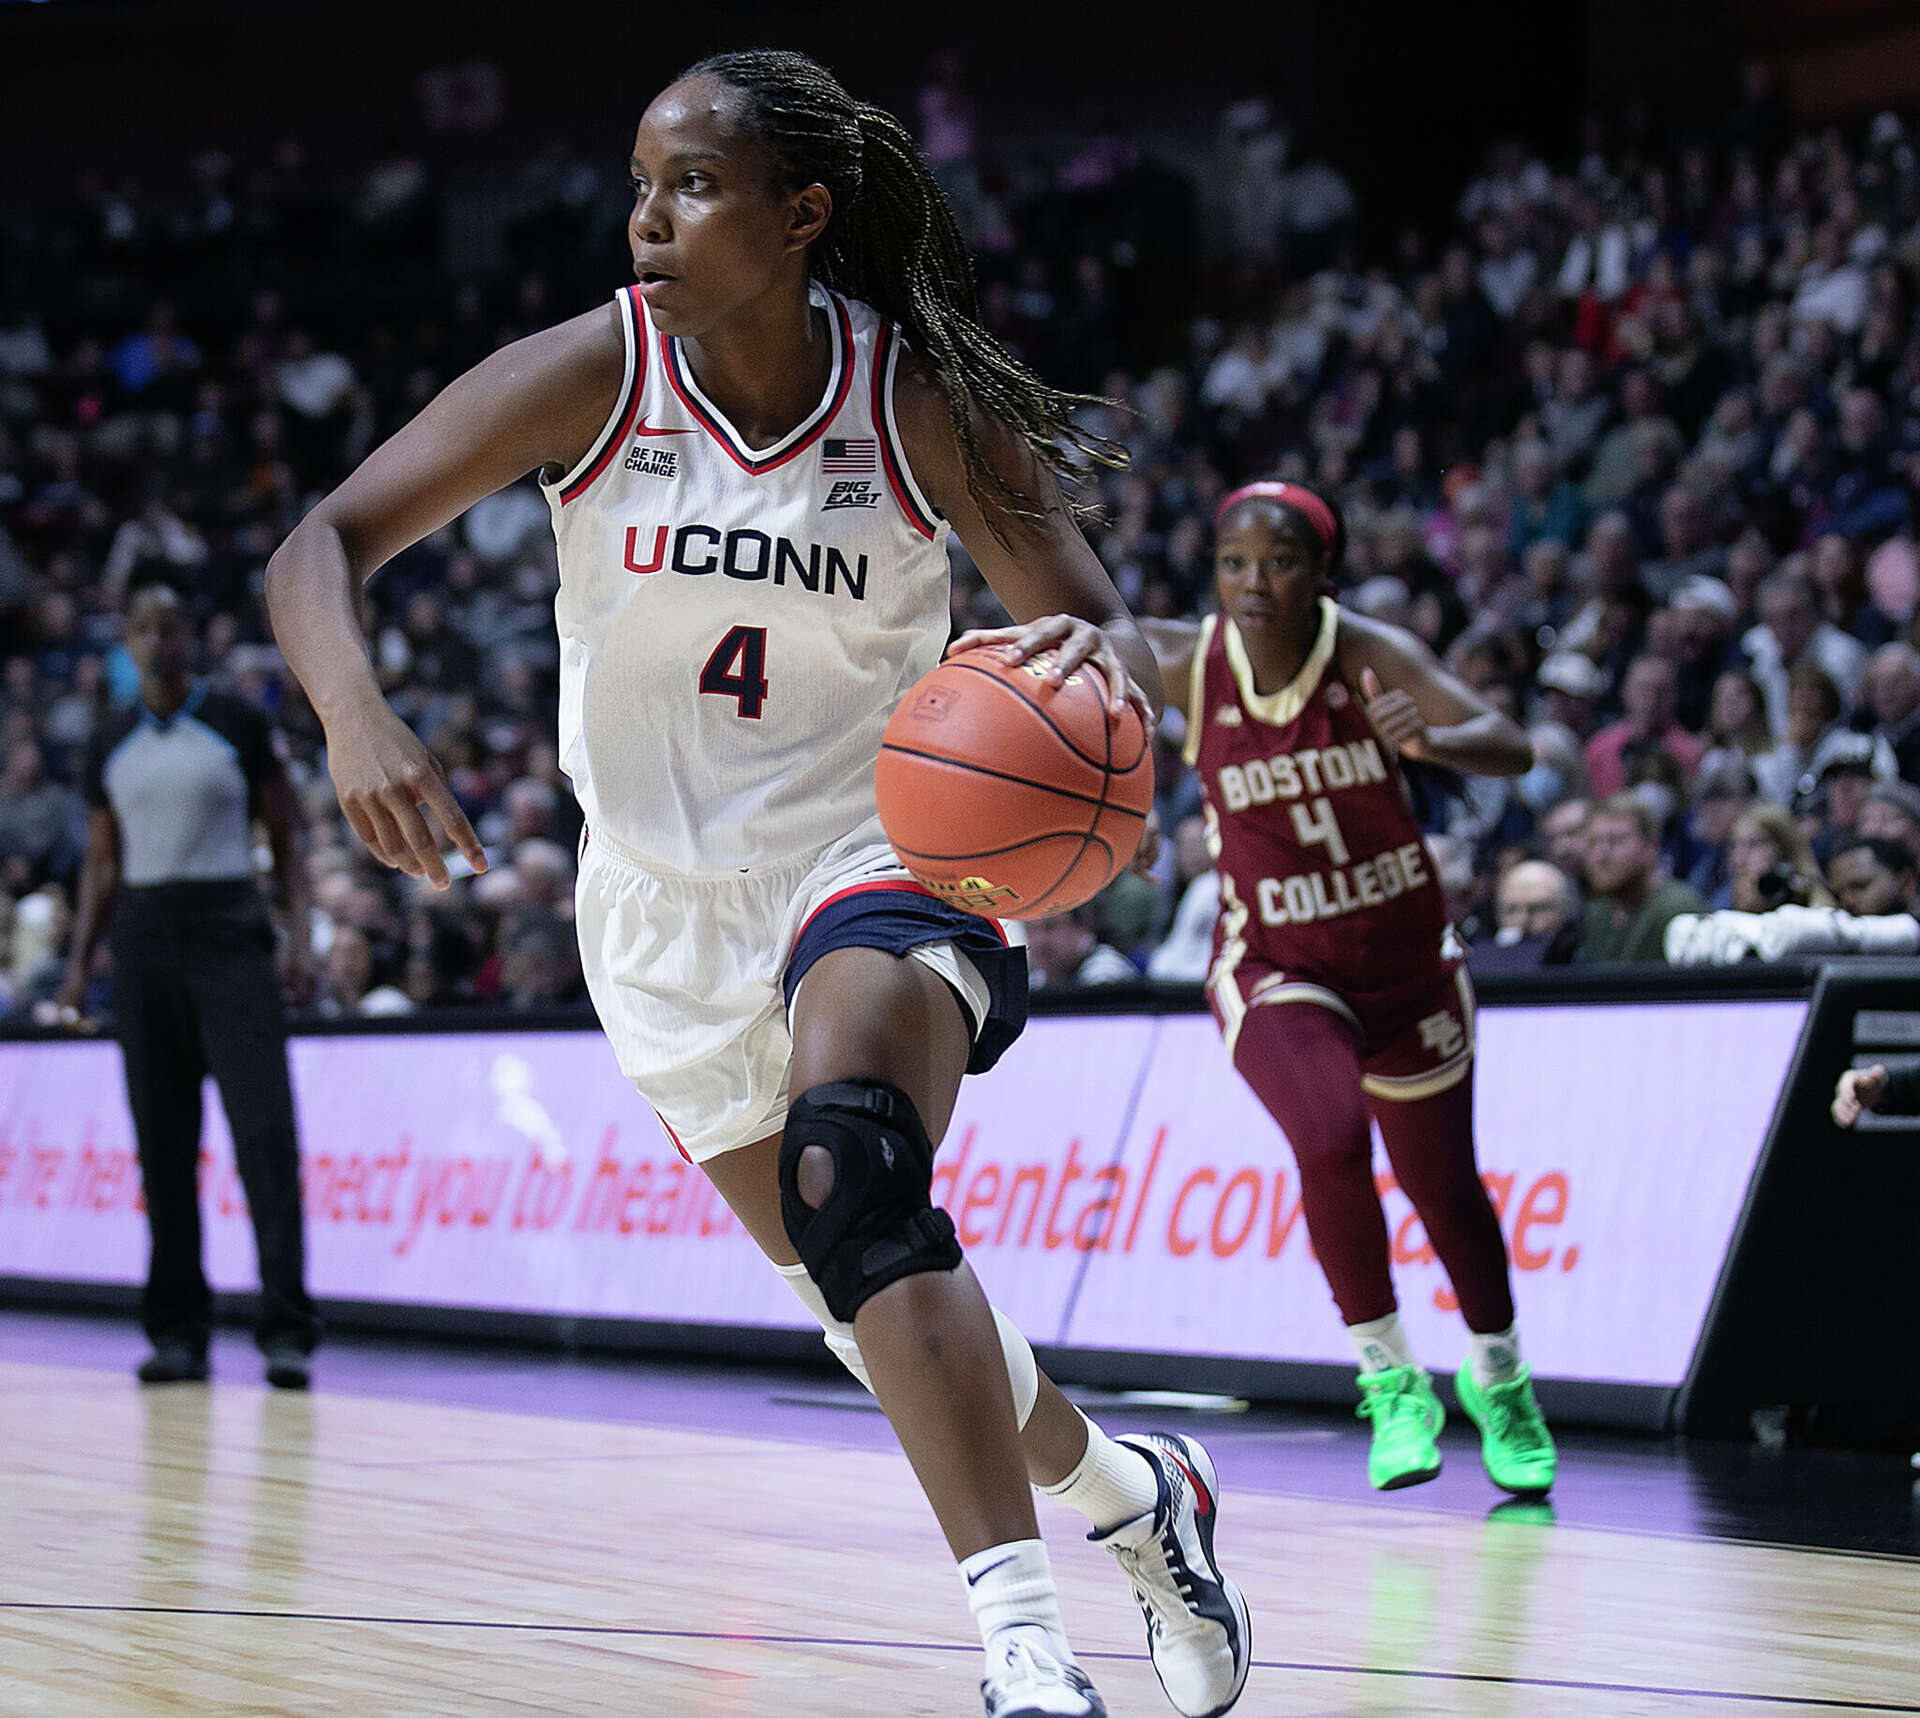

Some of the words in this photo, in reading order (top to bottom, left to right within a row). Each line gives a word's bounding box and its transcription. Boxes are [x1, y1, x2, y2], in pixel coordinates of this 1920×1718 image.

[624, 458, 677, 478] CHANGE
[631, 446, 650, 460] BE
[652, 450, 678, 465] THE
[831, 480, 872, 493] BIG
[825, 492, 882, 505] EAST
[623, 523, 868, 601] UCONN
[699, 624, 769, 720] 4
[1217, 738, 1388, 812] BOSTON
[1288, 796, 1351, 865] 4
[1255, 842, 1429, 927] COLLEGE
[929, 1123, 1170, 1253] dental
